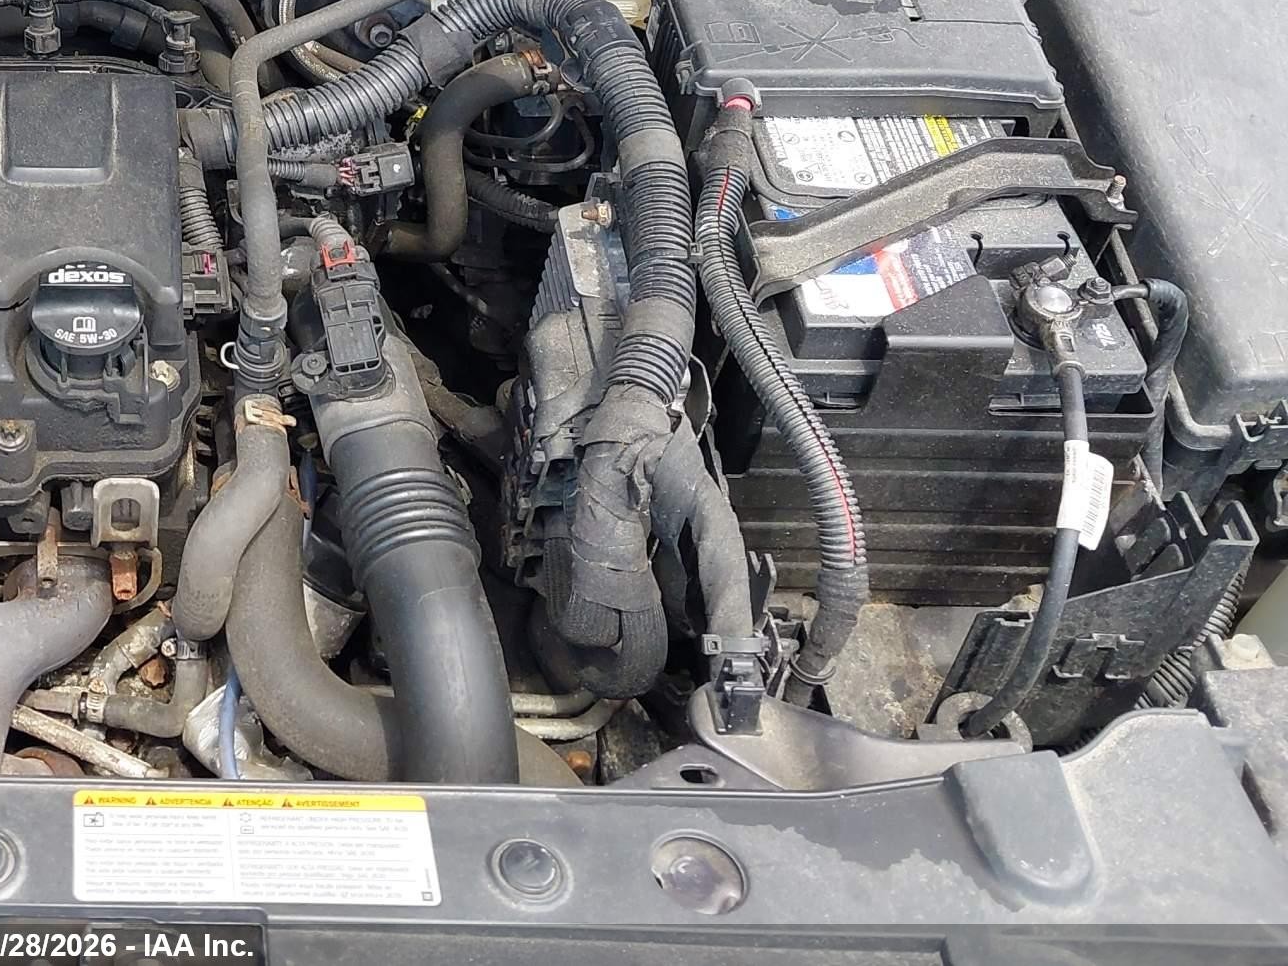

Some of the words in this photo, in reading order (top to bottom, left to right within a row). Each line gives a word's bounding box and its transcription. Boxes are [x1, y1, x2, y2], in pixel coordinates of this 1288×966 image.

[48, 268, 126, 283] dexos
[54, 328, 75, 343] SAE
[79, 328, 118, 344] 5W-30
[160, 798, 212, 806] ADVERTENCIA
[296, 800, 361, 808] AVERTISSEMENT
